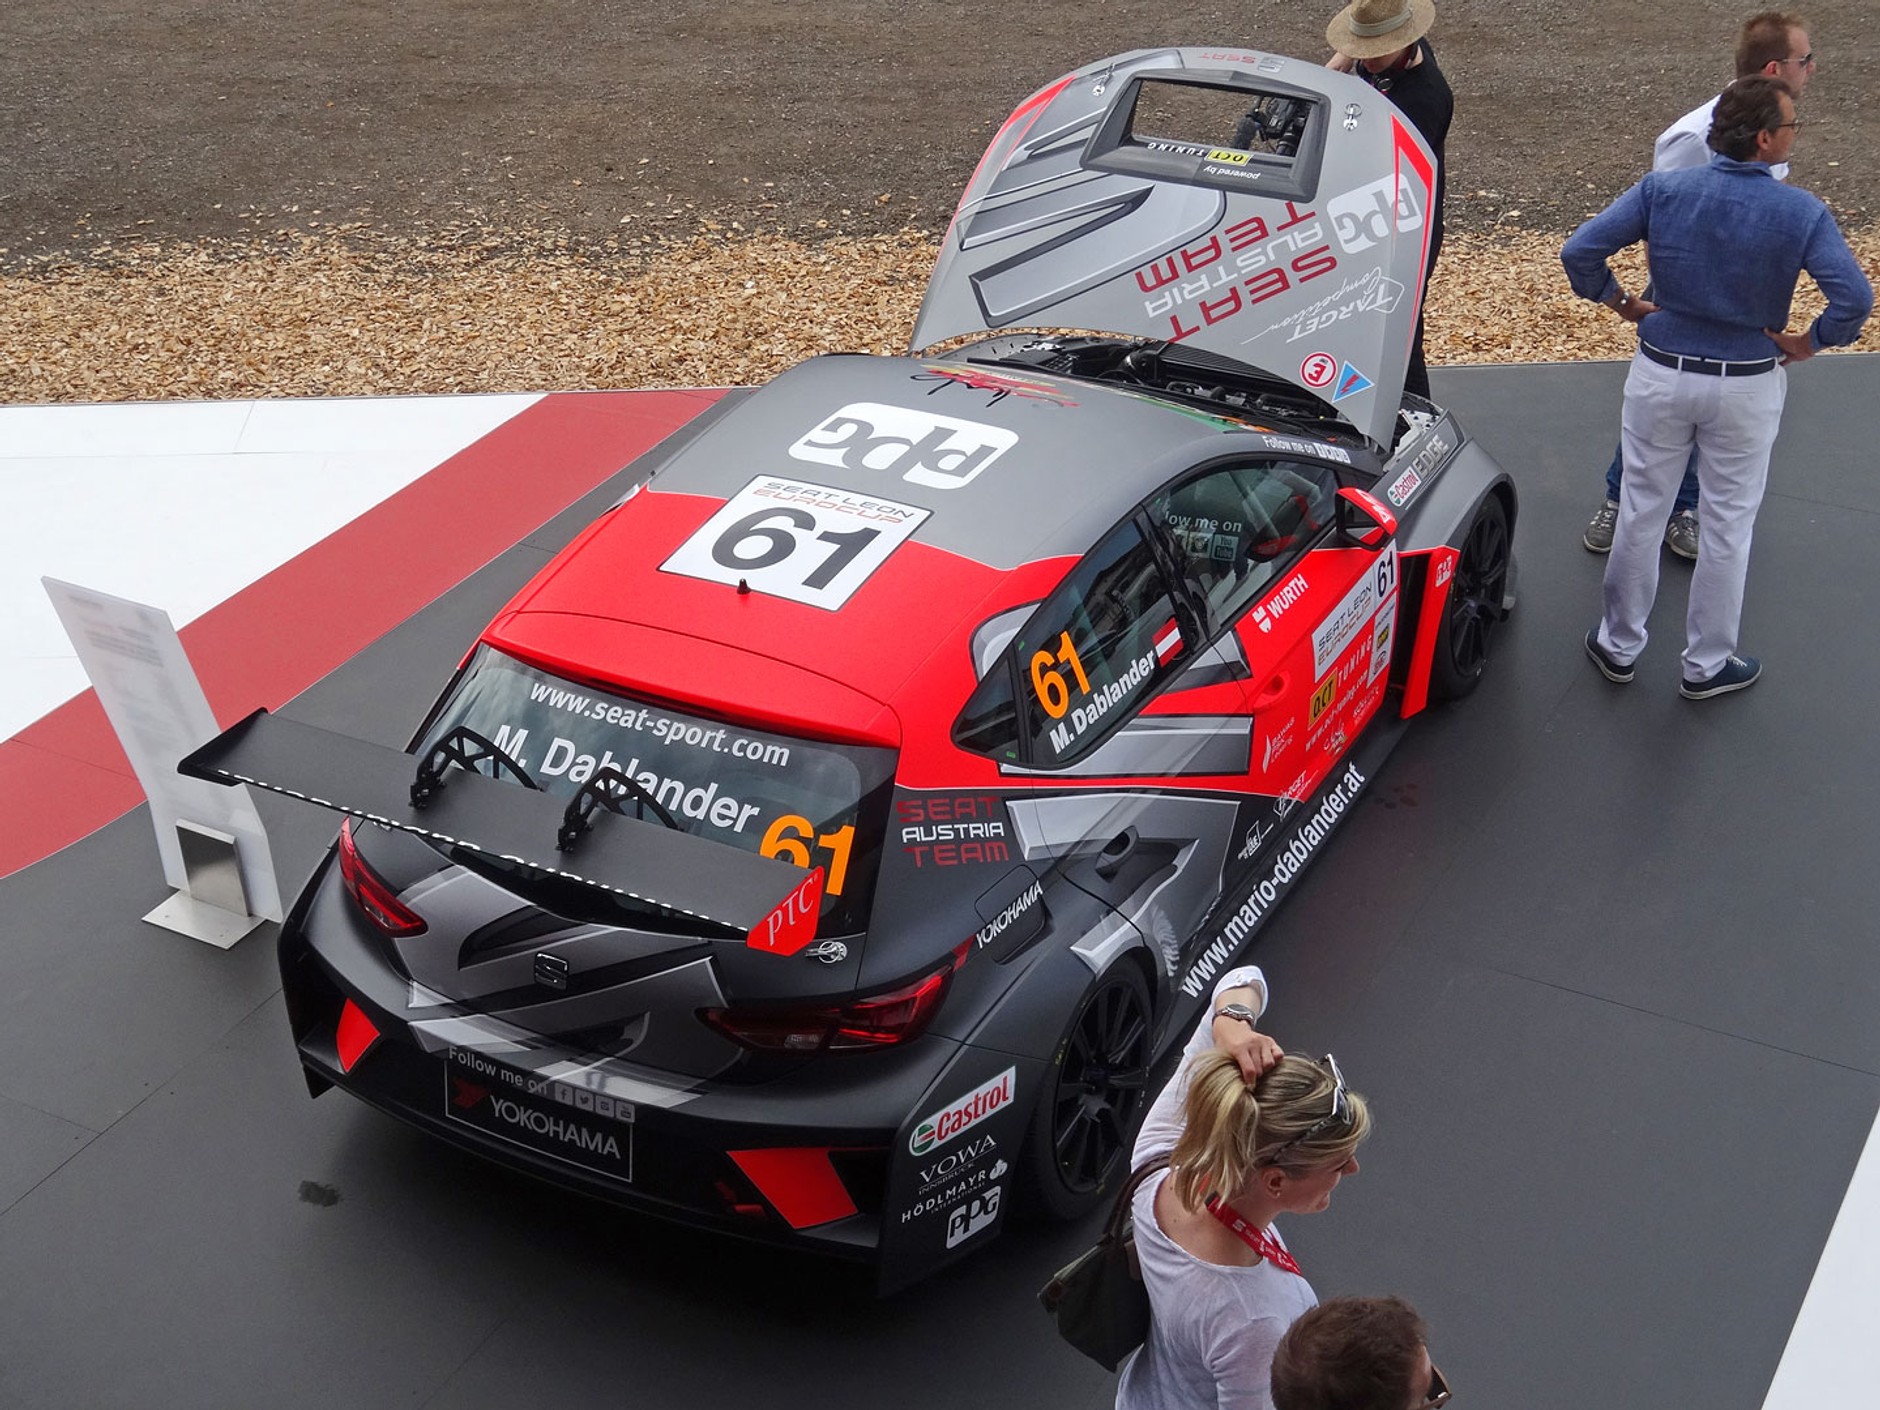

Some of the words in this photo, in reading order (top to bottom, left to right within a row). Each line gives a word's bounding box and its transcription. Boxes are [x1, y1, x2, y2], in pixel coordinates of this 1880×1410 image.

[1201, 53, 1256, 63] SEAT
[1147, 142, 1204, 157] TUNING
[1203, 165, 1216, 174] by
[1217, 168, 1260, 180] powered
[1134, 200, 1316, 293] TEAM
[1146, 222, 1324, 318] AUSTRIA
[1167, 245, 1338, 344] SEAT
[1286, 280, 1393, 344] TARGET
[1394, 469, 1419, 499] Castrol
[1412, 434, 1449, 480] EDGE
[752, 488, 904, 524] EUROCUP
[764, 481, 840, 499] SEAT
[842, 497, 915, 519] LEON
[1195, 518, 1219, 530] me
[1222, 521, 1242, 533] on
[712, 507, 882, 590] 61
[1377, 551, 1394, 598] 61
[1318, 596, 1371, 666] EUROCUP
[1319, 612, 1346, 652] SEAT
[1347, 581, 1372, 617] LEON
[1031, 631, 1091, 719] 61
[1338, 634, 1372, 688] TUNING
[530, 682, 791, 767] www.seat-sport.com
[1050, 722, 1075, 754] M.
[1071, 650, 1155, 735] Dablander
[493, 724, 528, 768] M.
[540, 736, 760, 833] Dablander
[896, 796, 998, 822] SEAT
[759, 814, 856, 896] 61
[902, 822, 1005, 843] AUSTRIA
[903, 841, 1009, 868] TEAM
[1181, 761, 1366, 998] www.mario-dablander.at
[976, 880, 1043, 949] YOKOHAMA
[449, 1046, 496, 1076] Follow
[501, 1069, 524, 1087] me
[527, 1079, 548, 1095] on
[489, 1093, 621, 1160] YOKOHAMA
[936, 1075, 1009, 1141] Castrol
[920, 1134, 997, 1184] VOWA
[901, 1169, 986, 1223] HÖDLMAYR
[949, 1192, 1000, 1239] PPG
